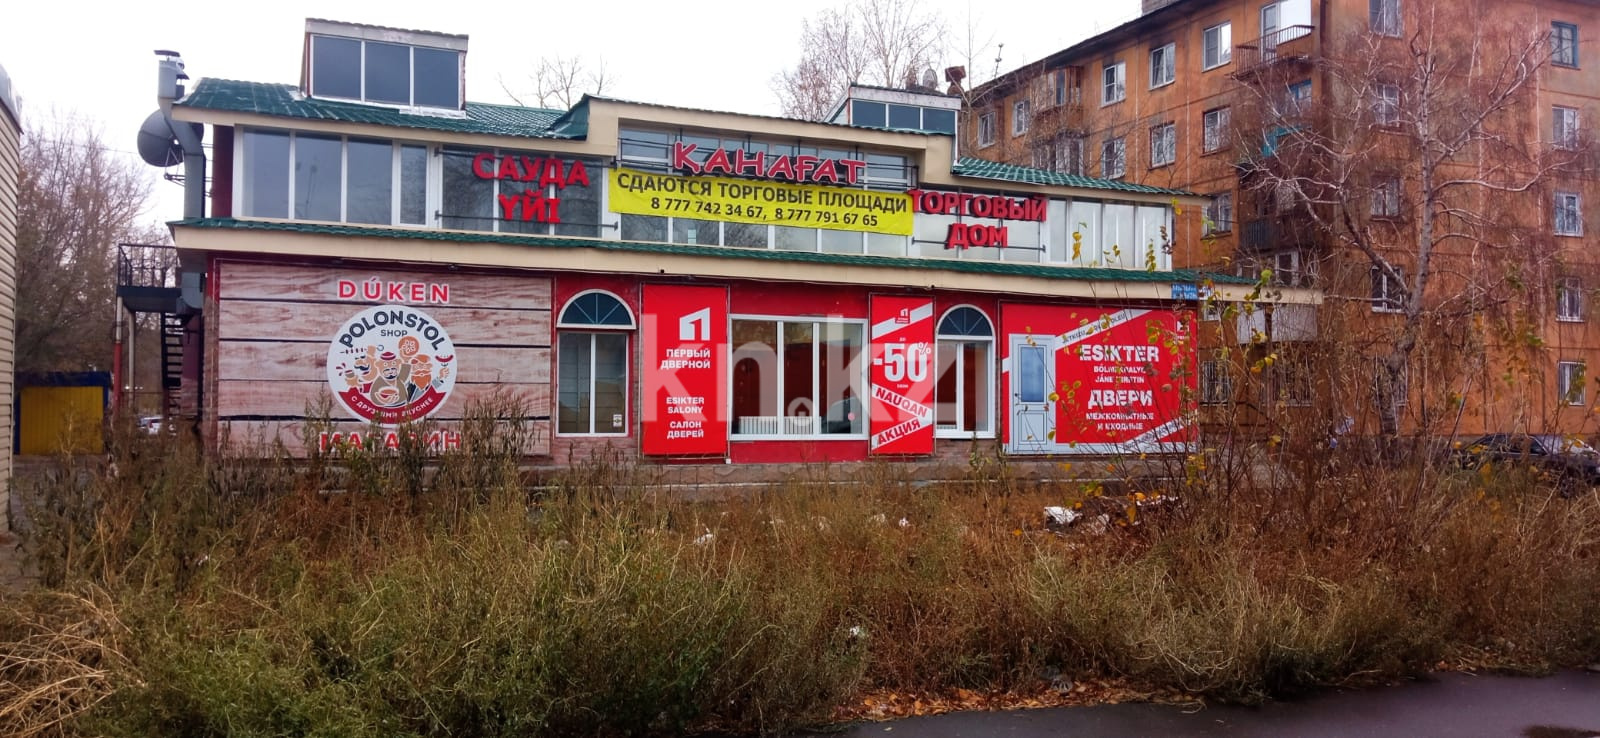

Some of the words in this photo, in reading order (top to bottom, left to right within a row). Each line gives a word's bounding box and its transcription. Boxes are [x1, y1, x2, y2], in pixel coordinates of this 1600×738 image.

[471, 152, 590, 189] САУДА
[497, 188, 561, 223] ҮЙІ
[617, 173, 712, 197] СДАЮТСЯ
[717, 182, 813, 205] ТОРГОВЫЕ
[818, 191, 907, 214] ПЛОЩАДИ
[908, 188, 1047, 223] ТОРГОВЫЙ
[651, 197, 660, 209] 8
[665, 198, 691, 212] 777
[695, 201, 721, 214] 742
[725, 204, 742, 216] 34
[746, 206, 768, 220] 67,
[775, 208, 784, 220] 8
[787, 208, 812, 221] 777
[815, 211, 839, 223] 791
[843, 213, 859, 225] 67
[862, 214, 878, 226] 65
[944, 223, 1008, 250] ДОМ
[338, 277, 450, 303] DÚKEN
[339, 310, 446, 351] POLONSTOL
[380, 329, 408, 338] SHOP
[660, 359, 711, 370] ДВЕРНОЙ
[666, 348, 711, 358] ПЕРВЫЙ
[1079, 344, 1159, 362] ESIKTER
[666, 397, 705, 405] ESIKTER
[667, 406, 704, 414] SALONY
[875, 387, 928, 418] NAUQAN
[1087, 389, 1153, 409] ДВЕРИ
[666, 429, 705, 440] ДВЕРЕЙ
[669, 421, 702, 429] САЛОН
[878, 418, 921, 445] АКЦИЯ
